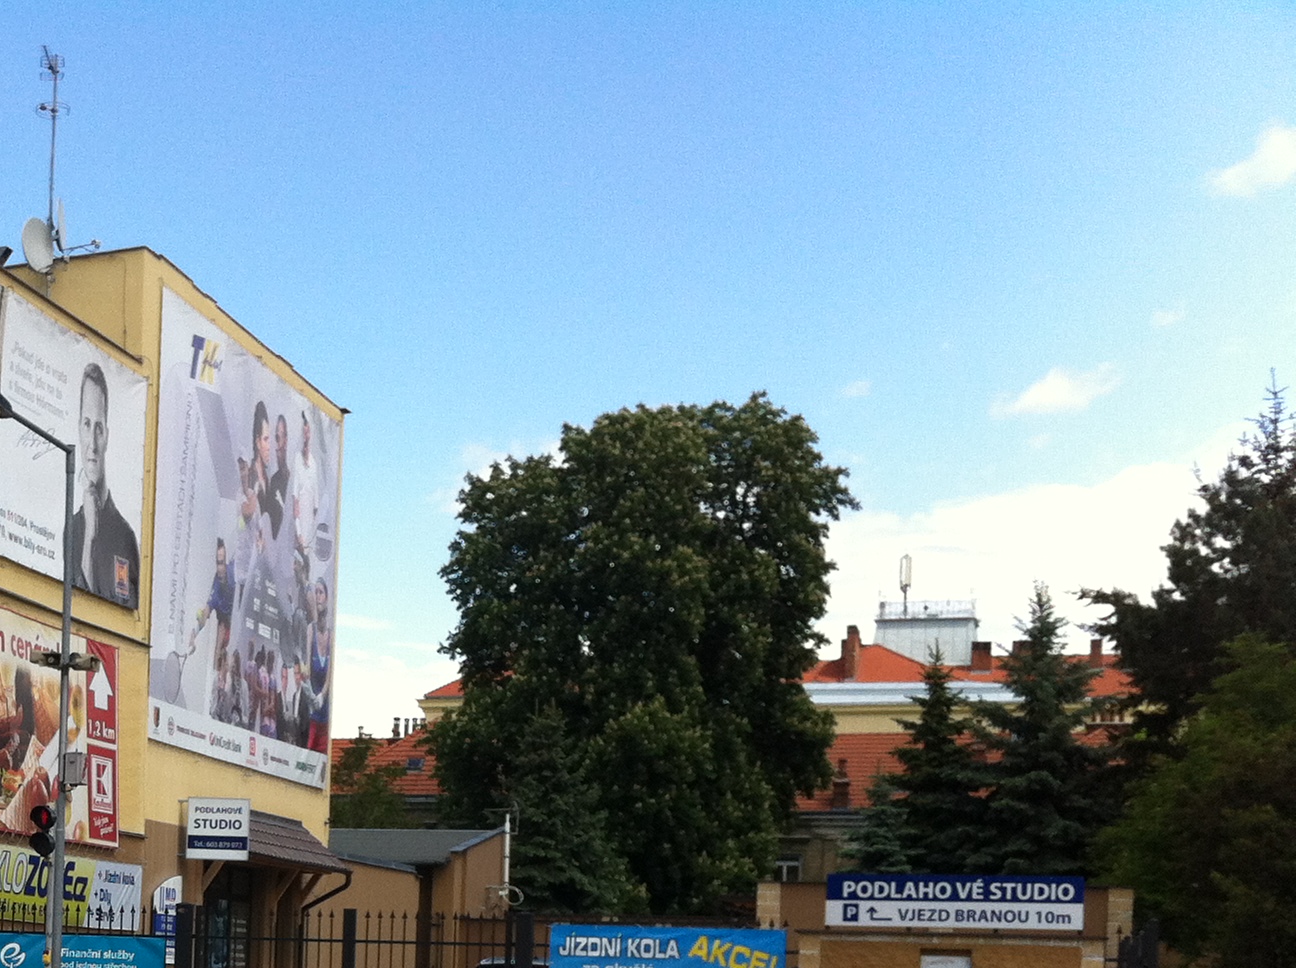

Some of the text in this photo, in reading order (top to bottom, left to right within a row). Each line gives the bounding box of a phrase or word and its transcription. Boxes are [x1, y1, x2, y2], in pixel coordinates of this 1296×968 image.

[102, 721, 115, 741] km
[195, 805, 243, 815] PODLAHOVÉ
[194, 818, 242, 830] STUDIO
[842, 878, 1075, 901] PODLAHO VÉ STUDIO
[845, 904, 1072, 925] P VJEZD BRANOU 10m
[60, 948, 135, 962] Finanční služby
[559, 931, 622, 957] JÍZDNÍ
[627, 937, 680, 960] KOLA
